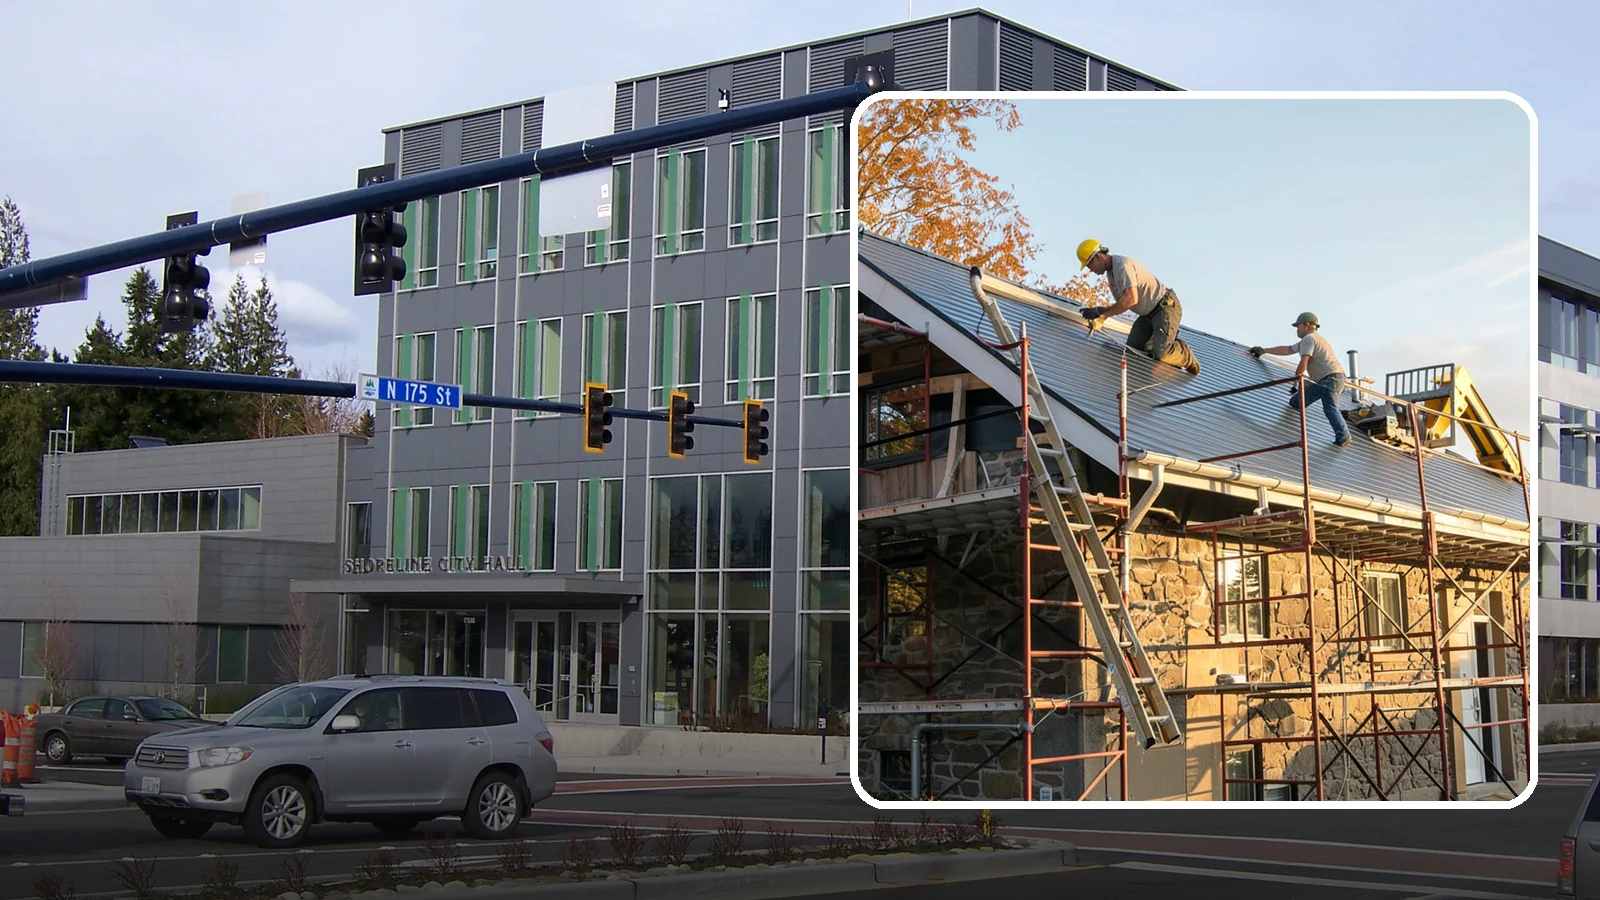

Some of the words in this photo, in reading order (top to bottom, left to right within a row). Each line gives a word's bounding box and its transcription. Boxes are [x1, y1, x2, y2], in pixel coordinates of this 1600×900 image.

[387, 380, 396, 400] N
[405, 382, 427, 403] 175
[436, 386, 451, 406] St
[343, 557, 432, 574] SHORELINE
[438, 556, 476, 572] CITY
[484, 555, 526, 571] HALL
